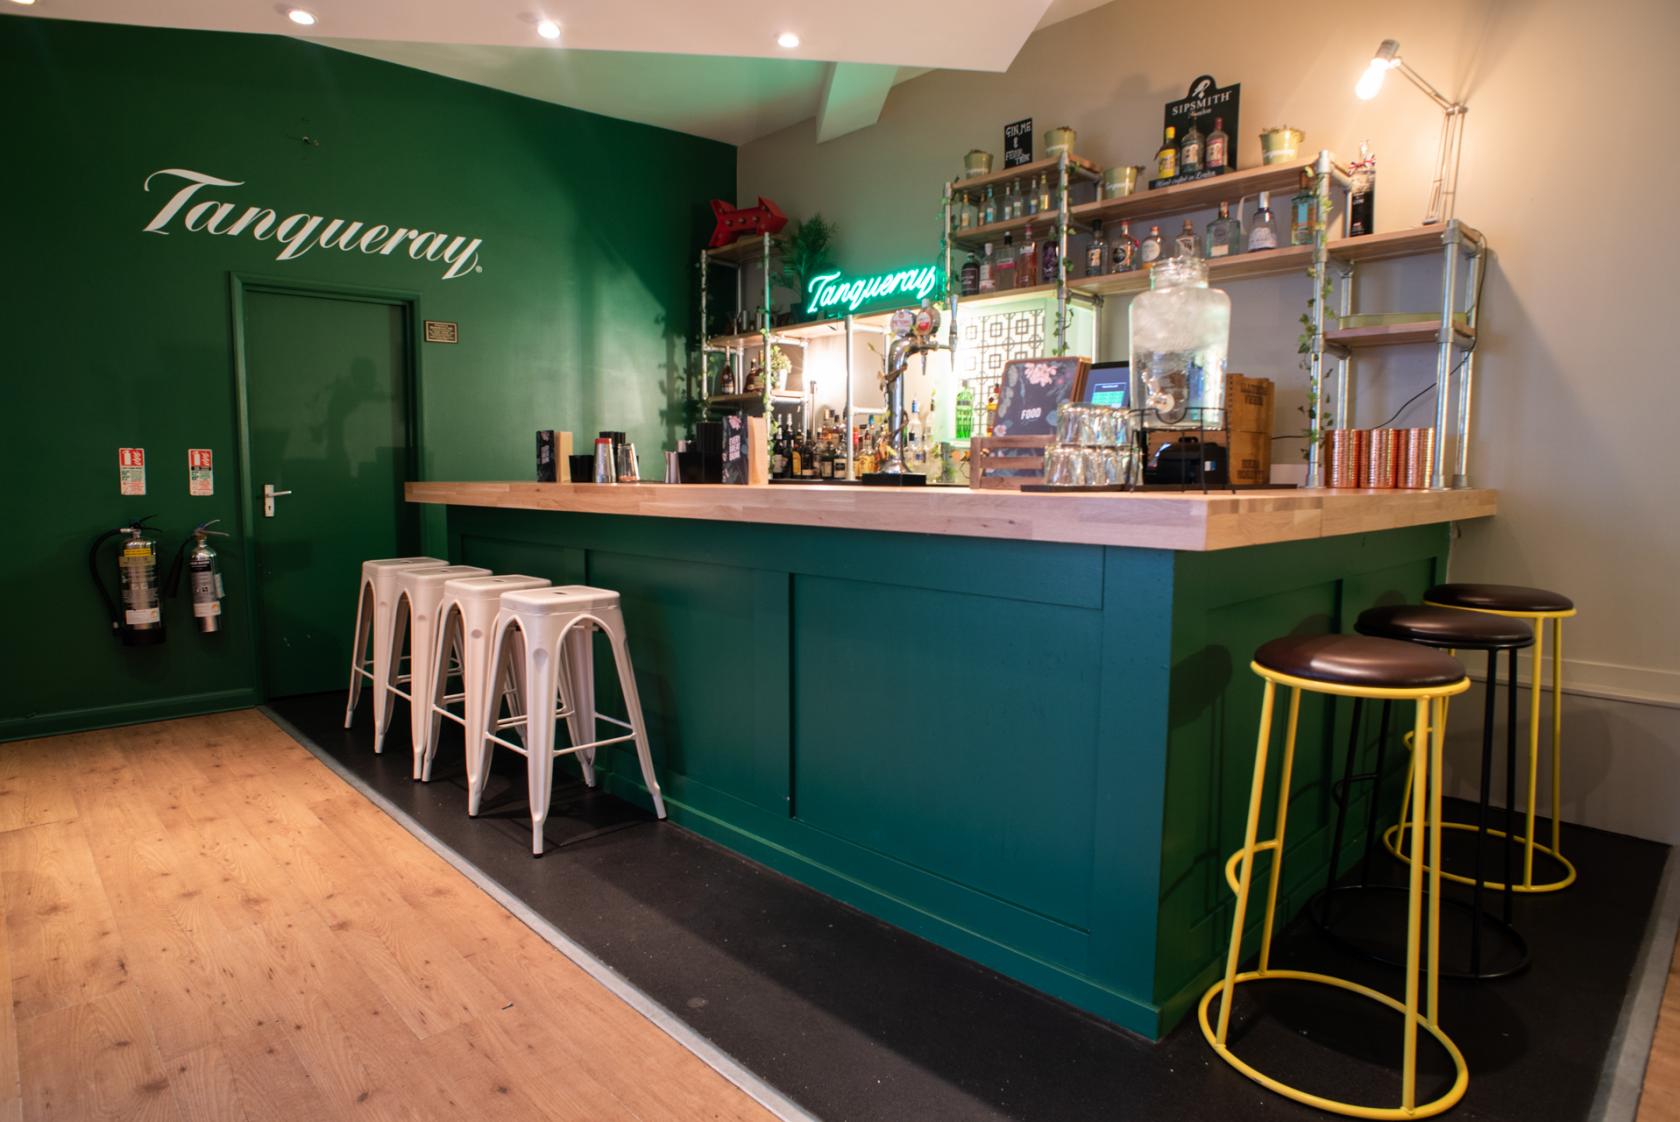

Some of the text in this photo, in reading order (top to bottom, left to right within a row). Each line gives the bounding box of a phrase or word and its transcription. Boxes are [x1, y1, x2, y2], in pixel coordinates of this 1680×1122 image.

[1172, 92, 1231, 115] SIPSMITH
[142, 168, 482, 280] Tanqueray
[807, 265, 936, 313] Tanqueray
[1020, 408, 1041, 420] FOOD
